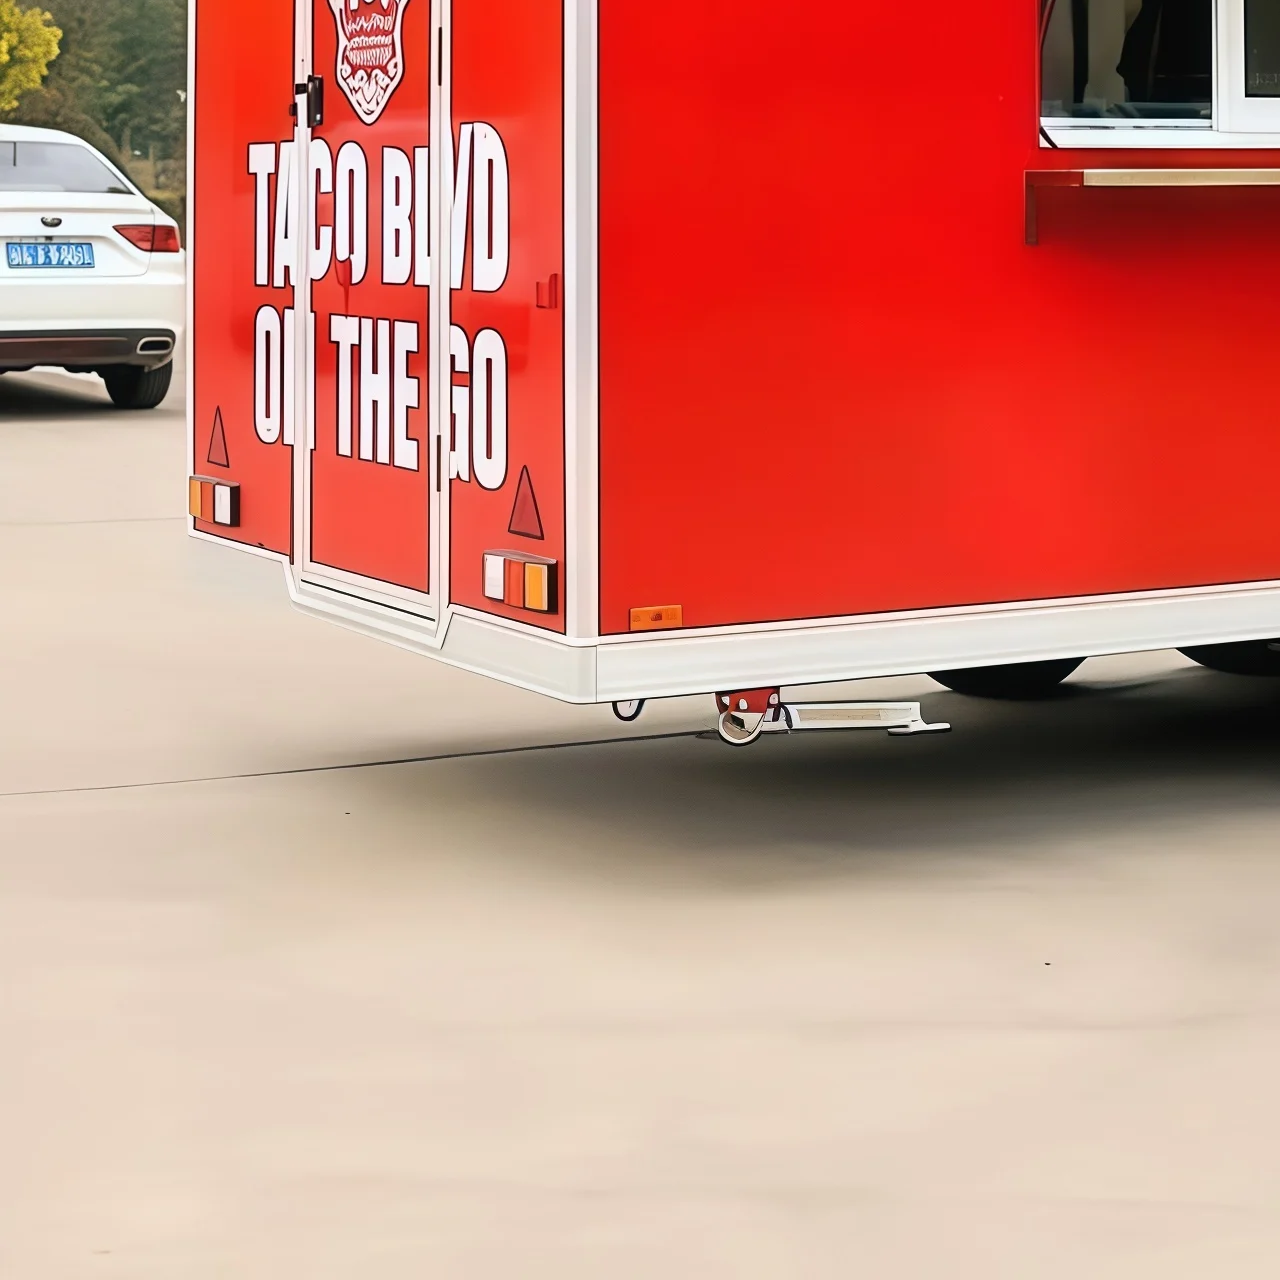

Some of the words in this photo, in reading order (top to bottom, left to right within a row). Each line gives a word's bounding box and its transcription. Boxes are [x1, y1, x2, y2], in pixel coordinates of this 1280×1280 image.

[248, 137, 369, 288] TACO
[381, 121, 510, 292] BLVD
[329, 313, 419, 472] THE
[450, 324, 508, 491] GO
